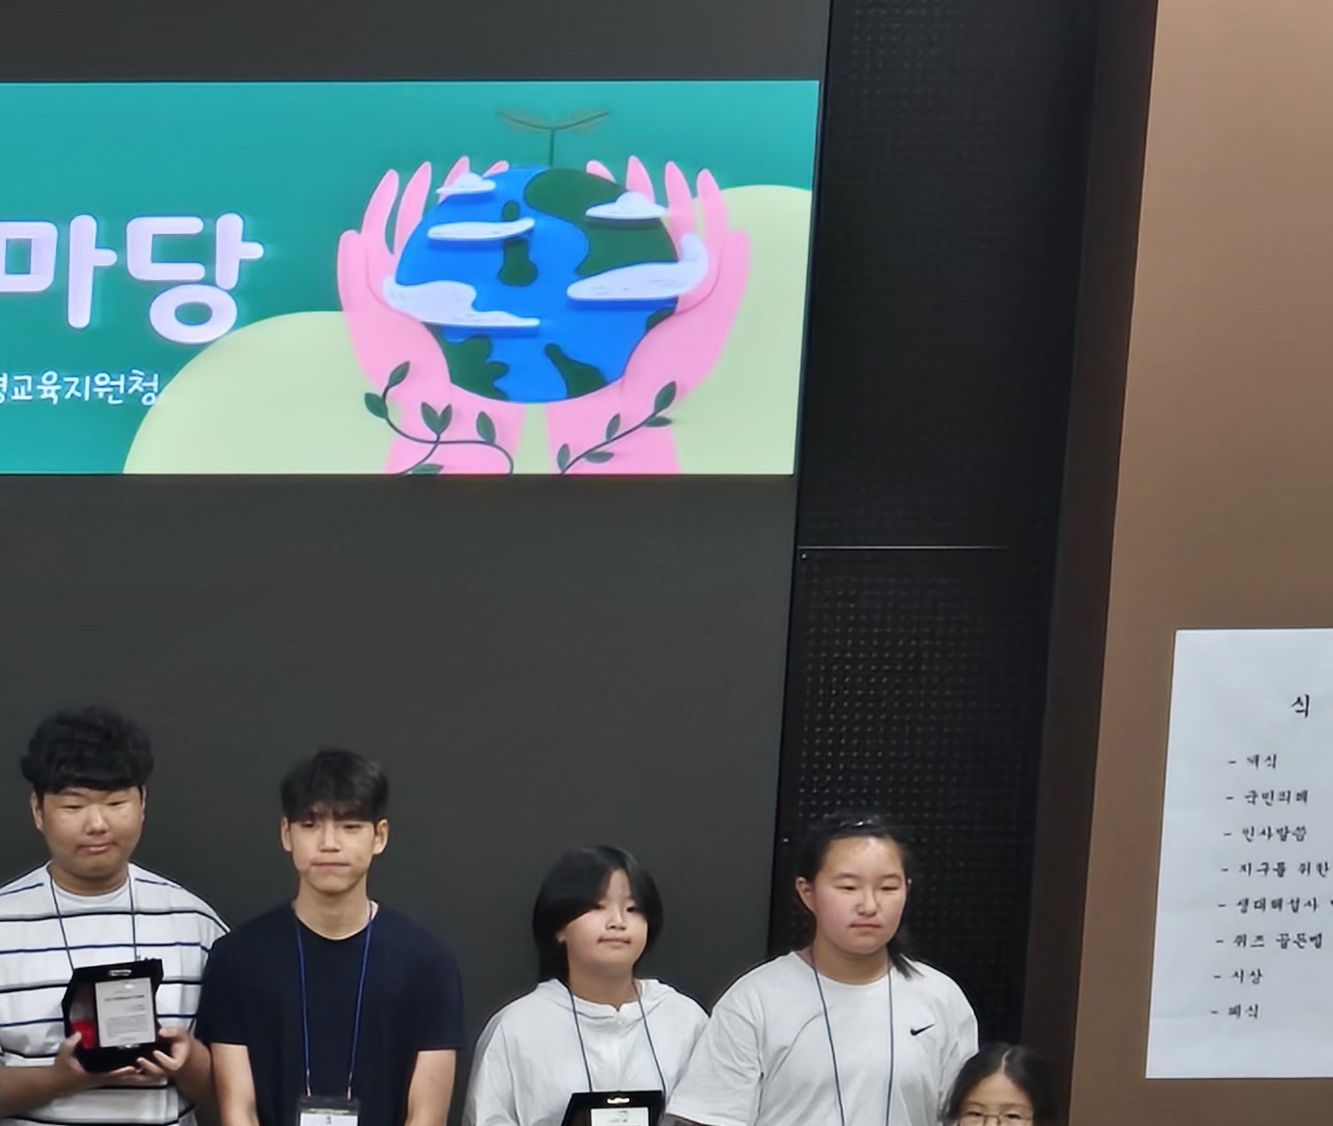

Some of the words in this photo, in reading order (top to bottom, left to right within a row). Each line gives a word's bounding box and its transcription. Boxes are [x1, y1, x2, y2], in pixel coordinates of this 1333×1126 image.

[1290, 694, 1311, 717] 식
[1242, 826, 1307, 843] 인사말씀
[1232, 968, 1263, 984] 시상
